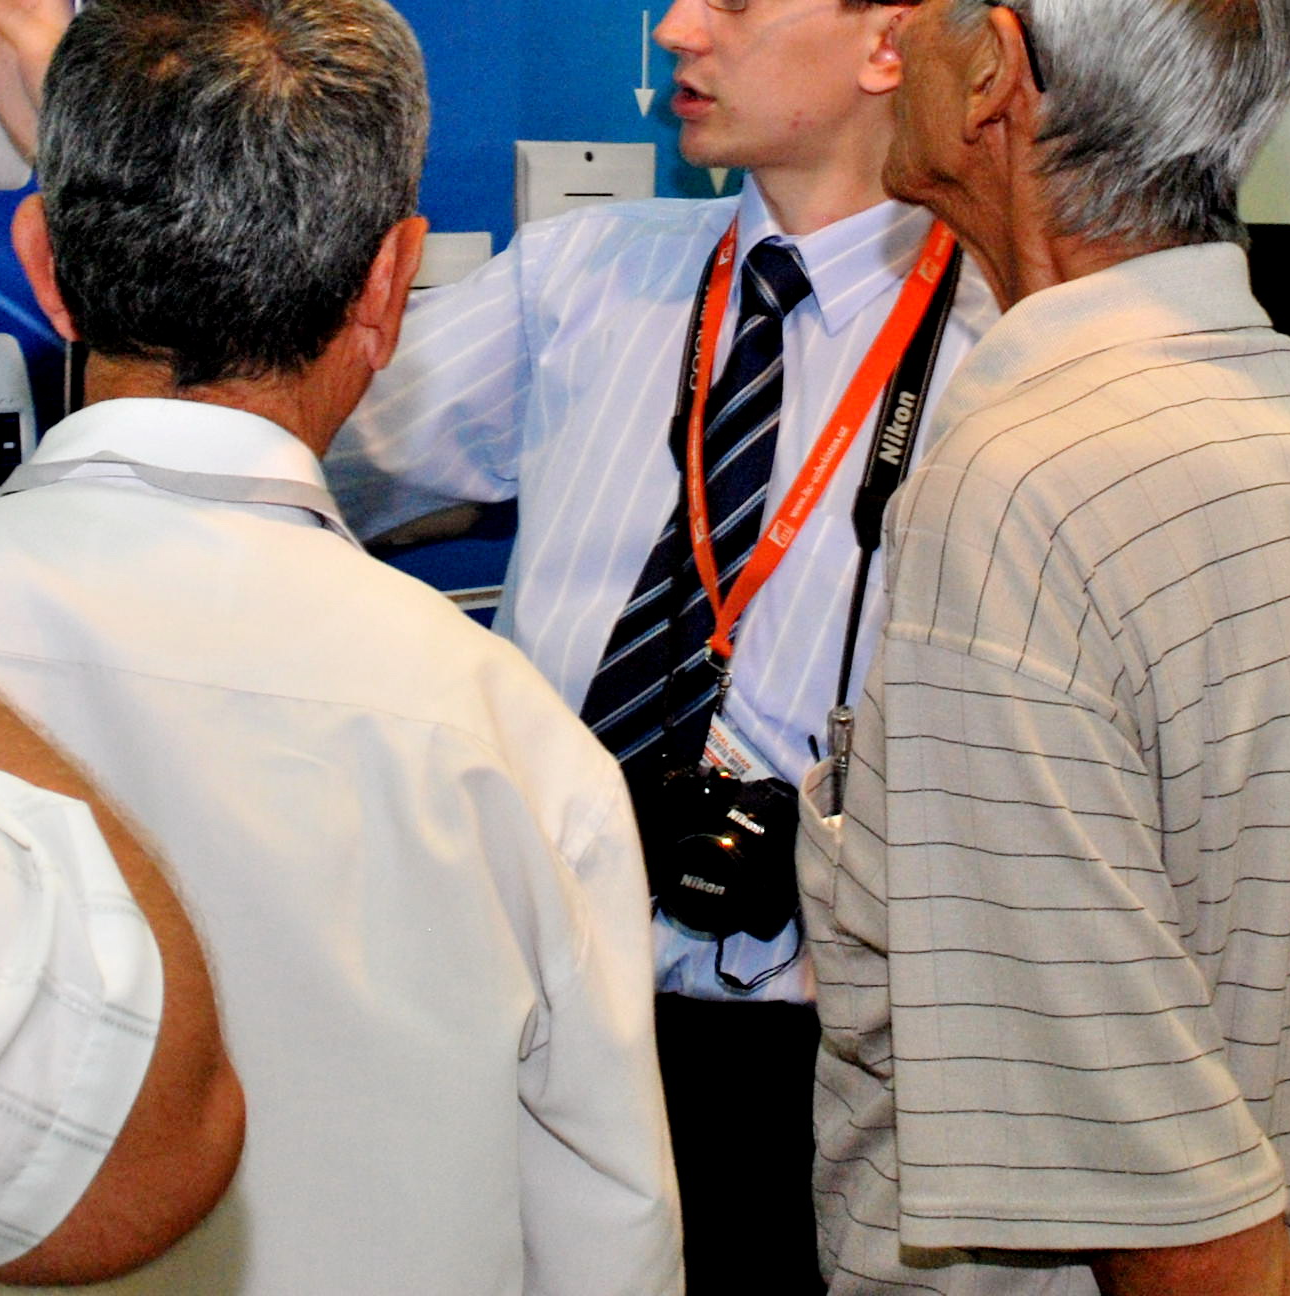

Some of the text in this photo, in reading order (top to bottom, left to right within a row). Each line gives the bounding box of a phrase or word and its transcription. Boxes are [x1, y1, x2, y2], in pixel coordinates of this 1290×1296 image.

[878, 390, 918, 466] Nikon
[727, 808, 764, 835] Nikon
[680, 873, 726, 895] Nikon
